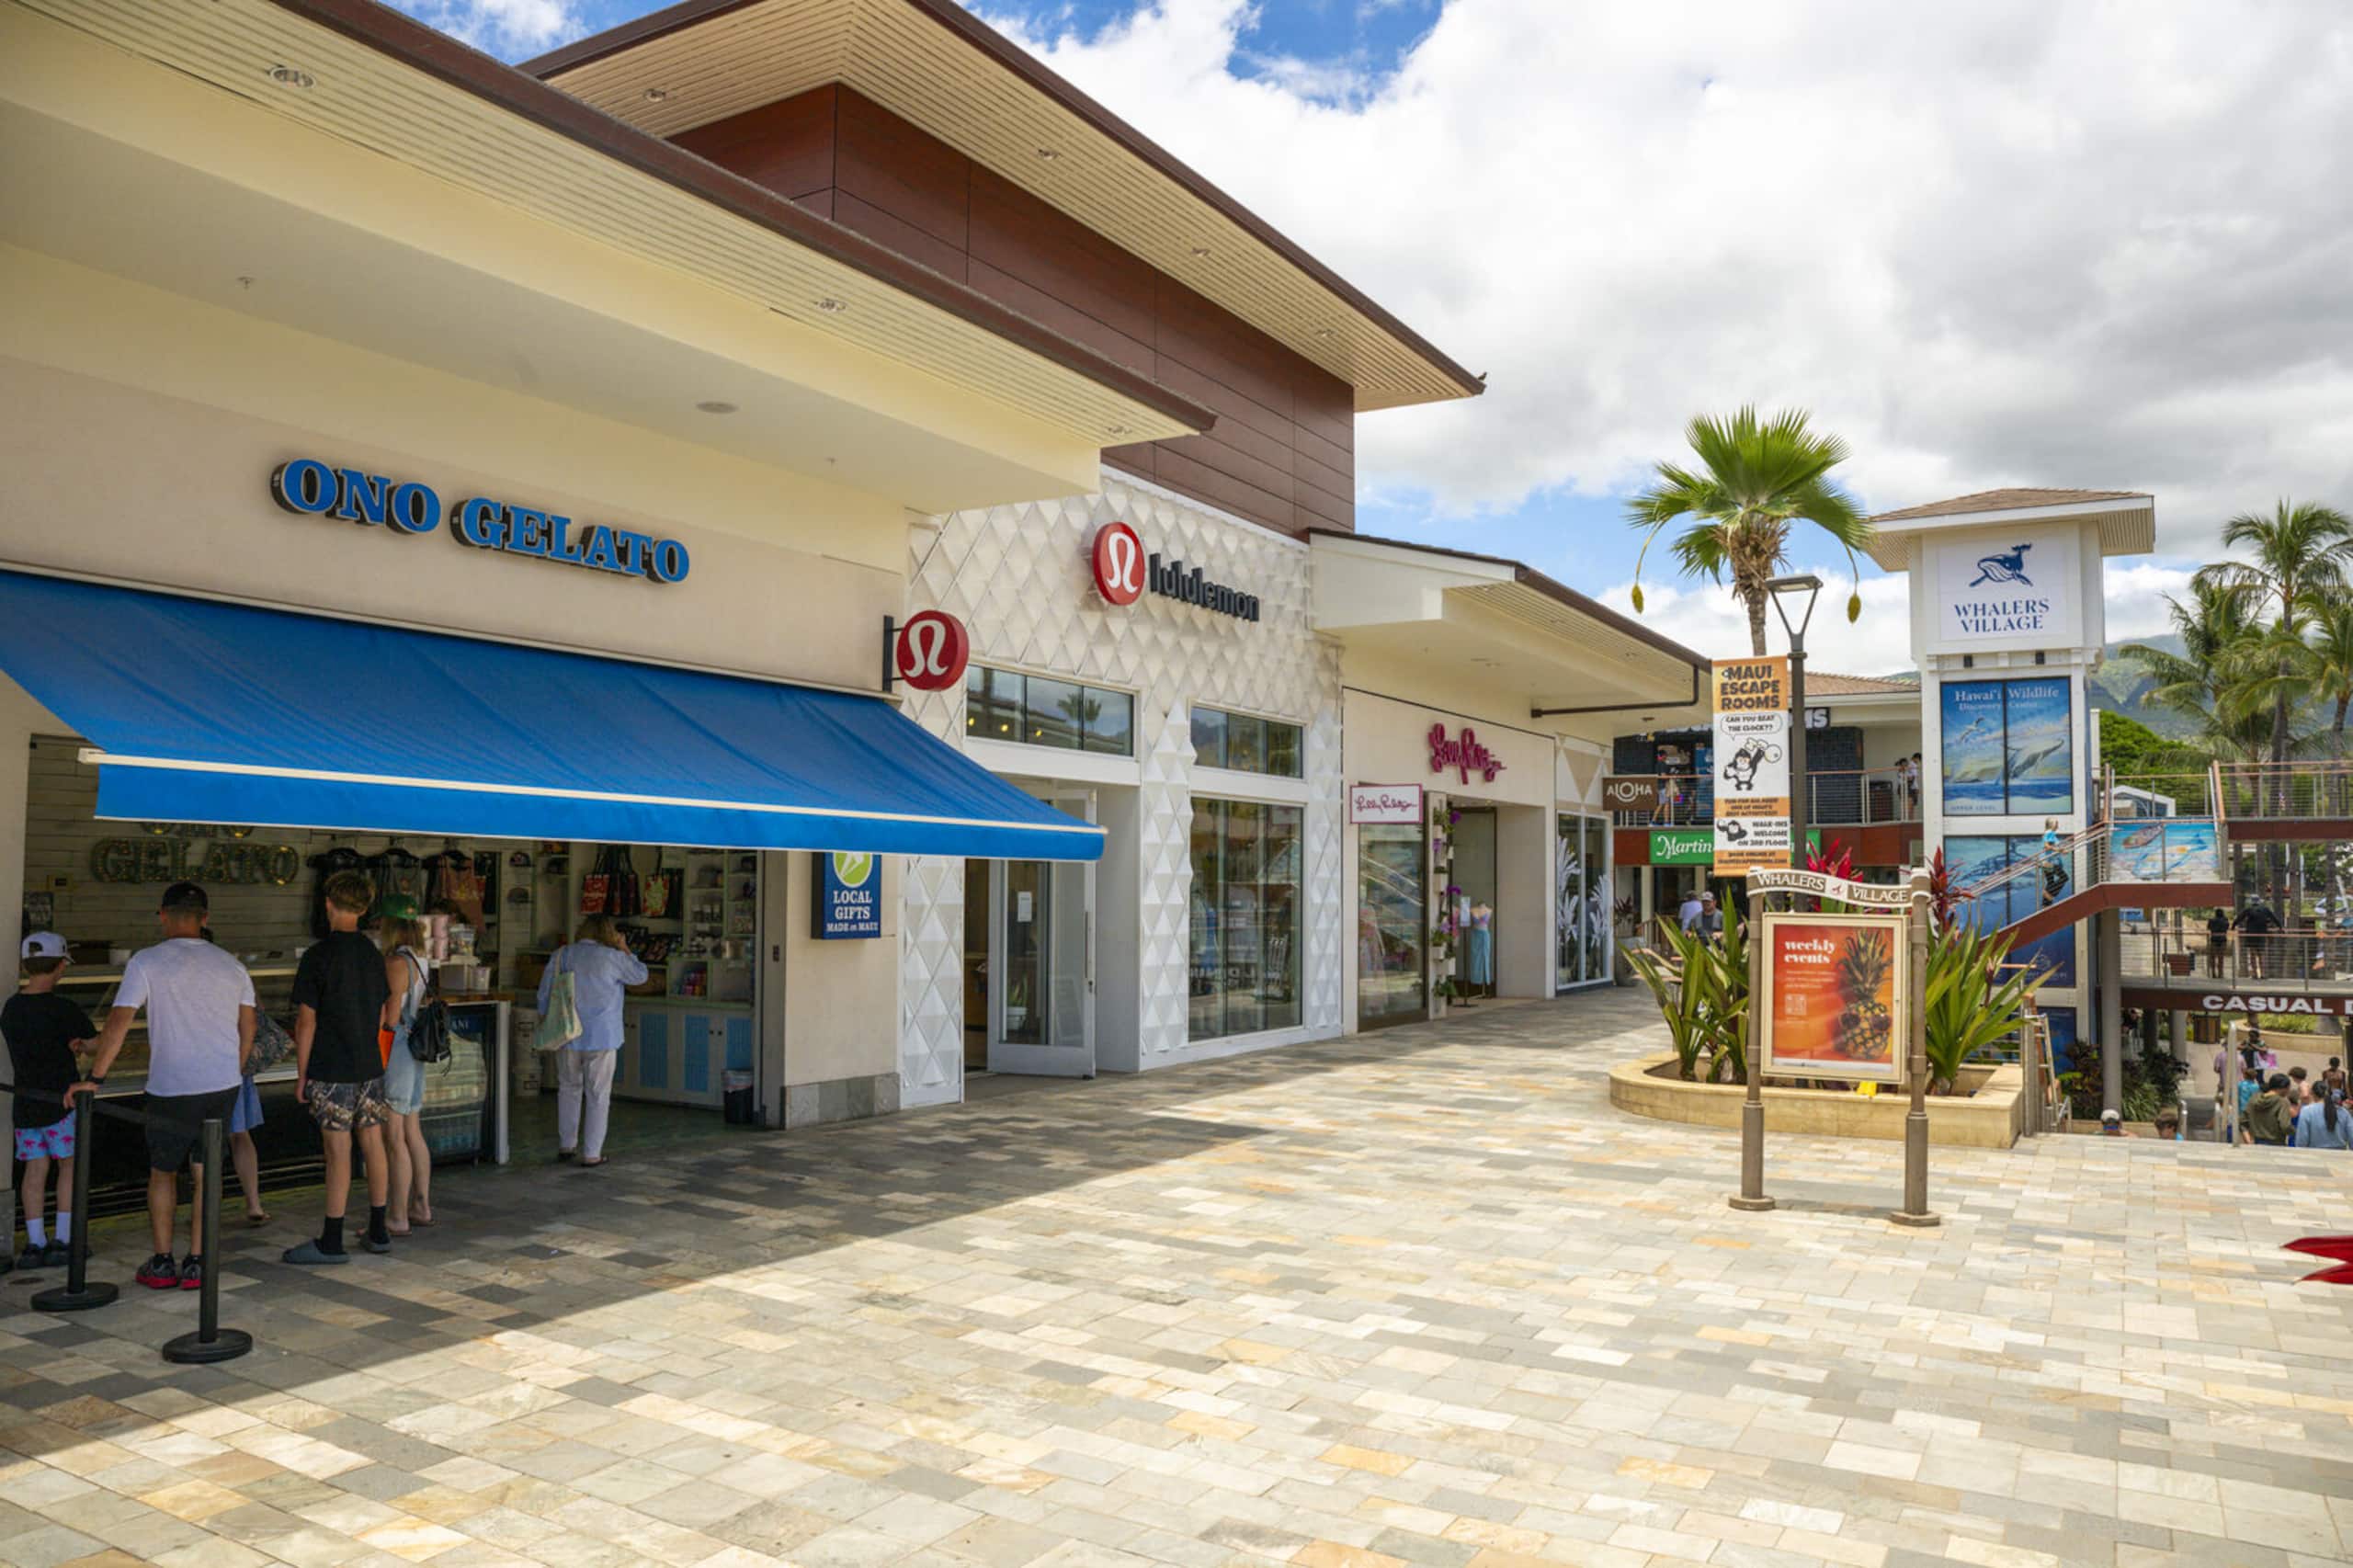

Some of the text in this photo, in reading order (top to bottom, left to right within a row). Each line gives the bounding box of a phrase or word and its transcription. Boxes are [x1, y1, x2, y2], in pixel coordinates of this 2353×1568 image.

[276, 458, 690, 584] ONO GELATO
[1149, 552, 1259, 622] lululemon
[1954, 597, 2050, 618] WHALERS
[1961, 615, 2043, 632] VILLAGE
[1727, 665, 1772, 680] MAUI
[1721, 679, 1780, 696] ESCAPE
[2007, 686, 2060, 699] Wildlife
[1721, 695, 1780, 710] ROOMS
[1606, 781, 1653, 802] ALOHA
[1656, 835, 1712, 859] Martin
[92, 836, 299, 887] GELATO
[833, 890, 873, 904] LOCAL
[1756, 874, 1908, 903] WHALERS VILLAGE
[835, 905, 870, 920] GIFTS
[827, 922, 849, 932] MADE
[1784, 938, 1836, 954] weekly
[1784, 953, 1831, 964] events
[2202, 994, 2334, 1014] CASUAL
